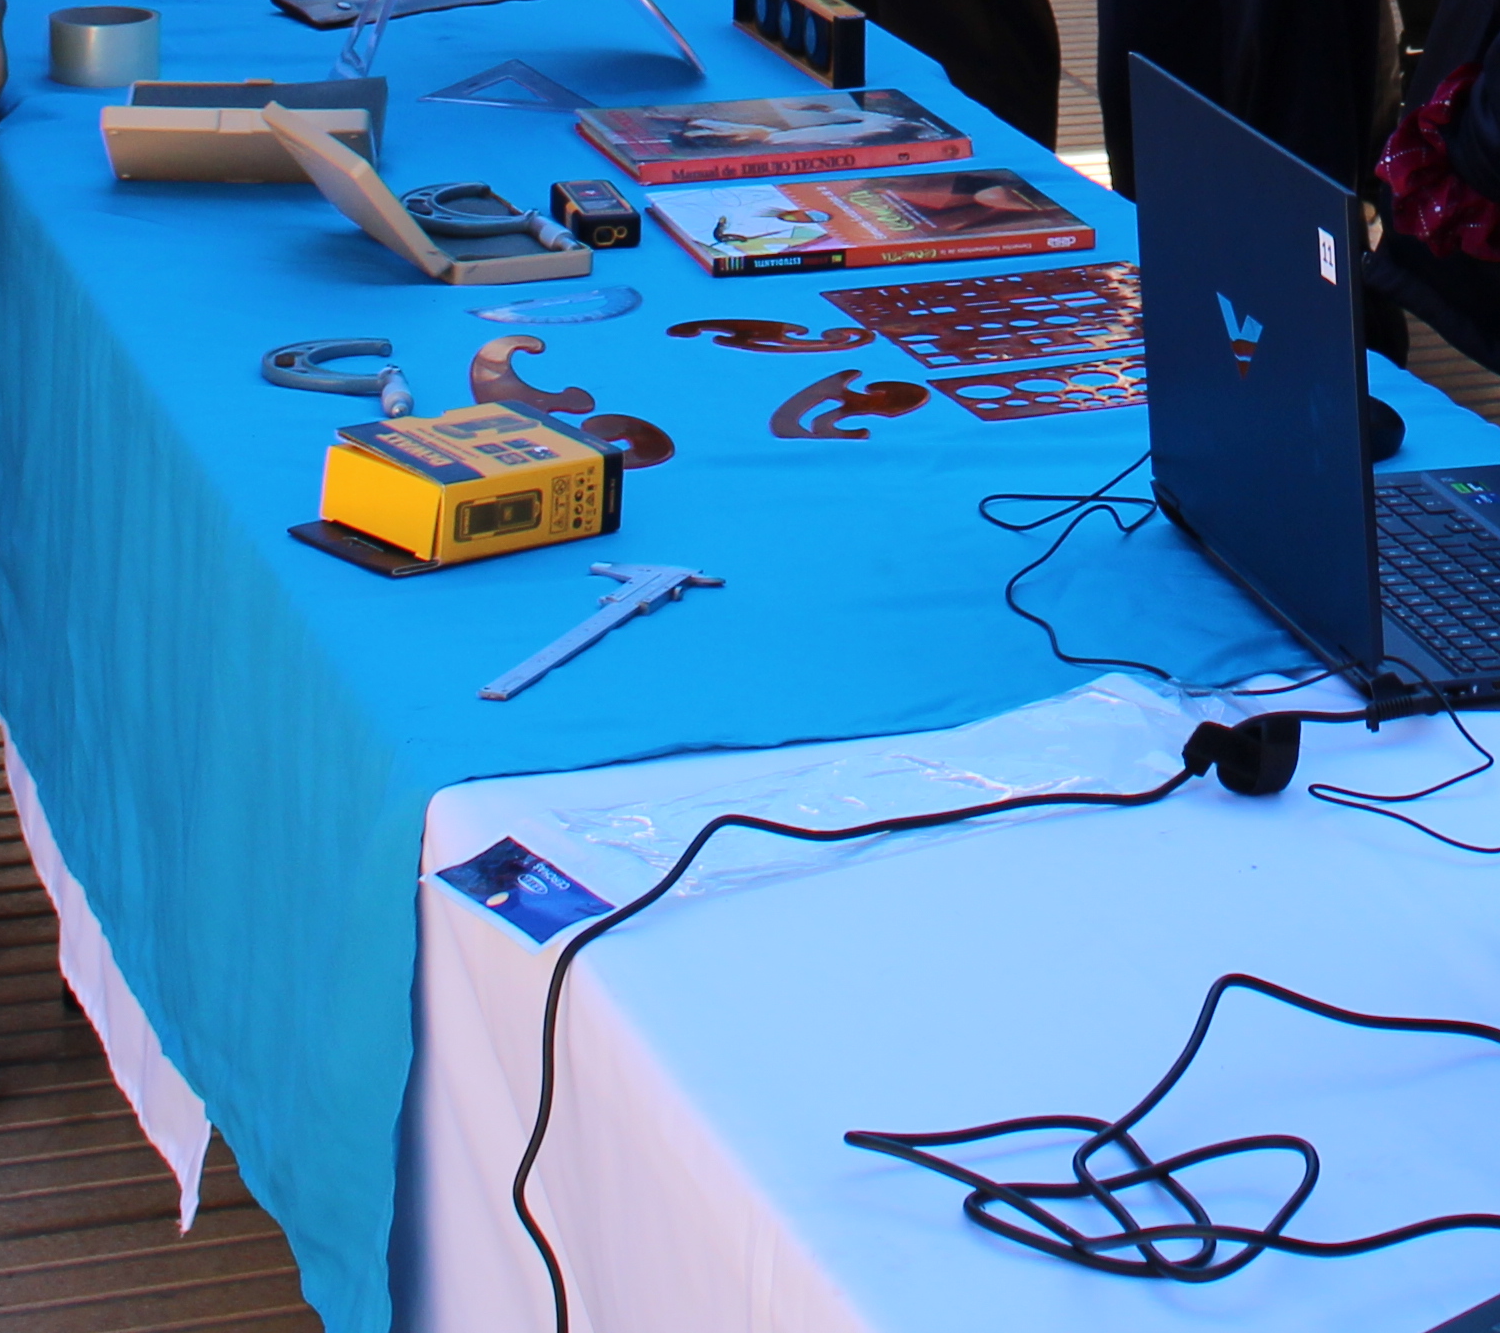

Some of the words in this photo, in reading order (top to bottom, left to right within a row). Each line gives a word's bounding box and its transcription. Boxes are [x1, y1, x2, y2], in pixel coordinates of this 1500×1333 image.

[741, 160, 791, 176] DIBUJO
[791, 154, 855, 173] TECNICO
[753, 256, 802, 269] ESTUDIANTIL
[1321, 242, 1334, 268] 11
